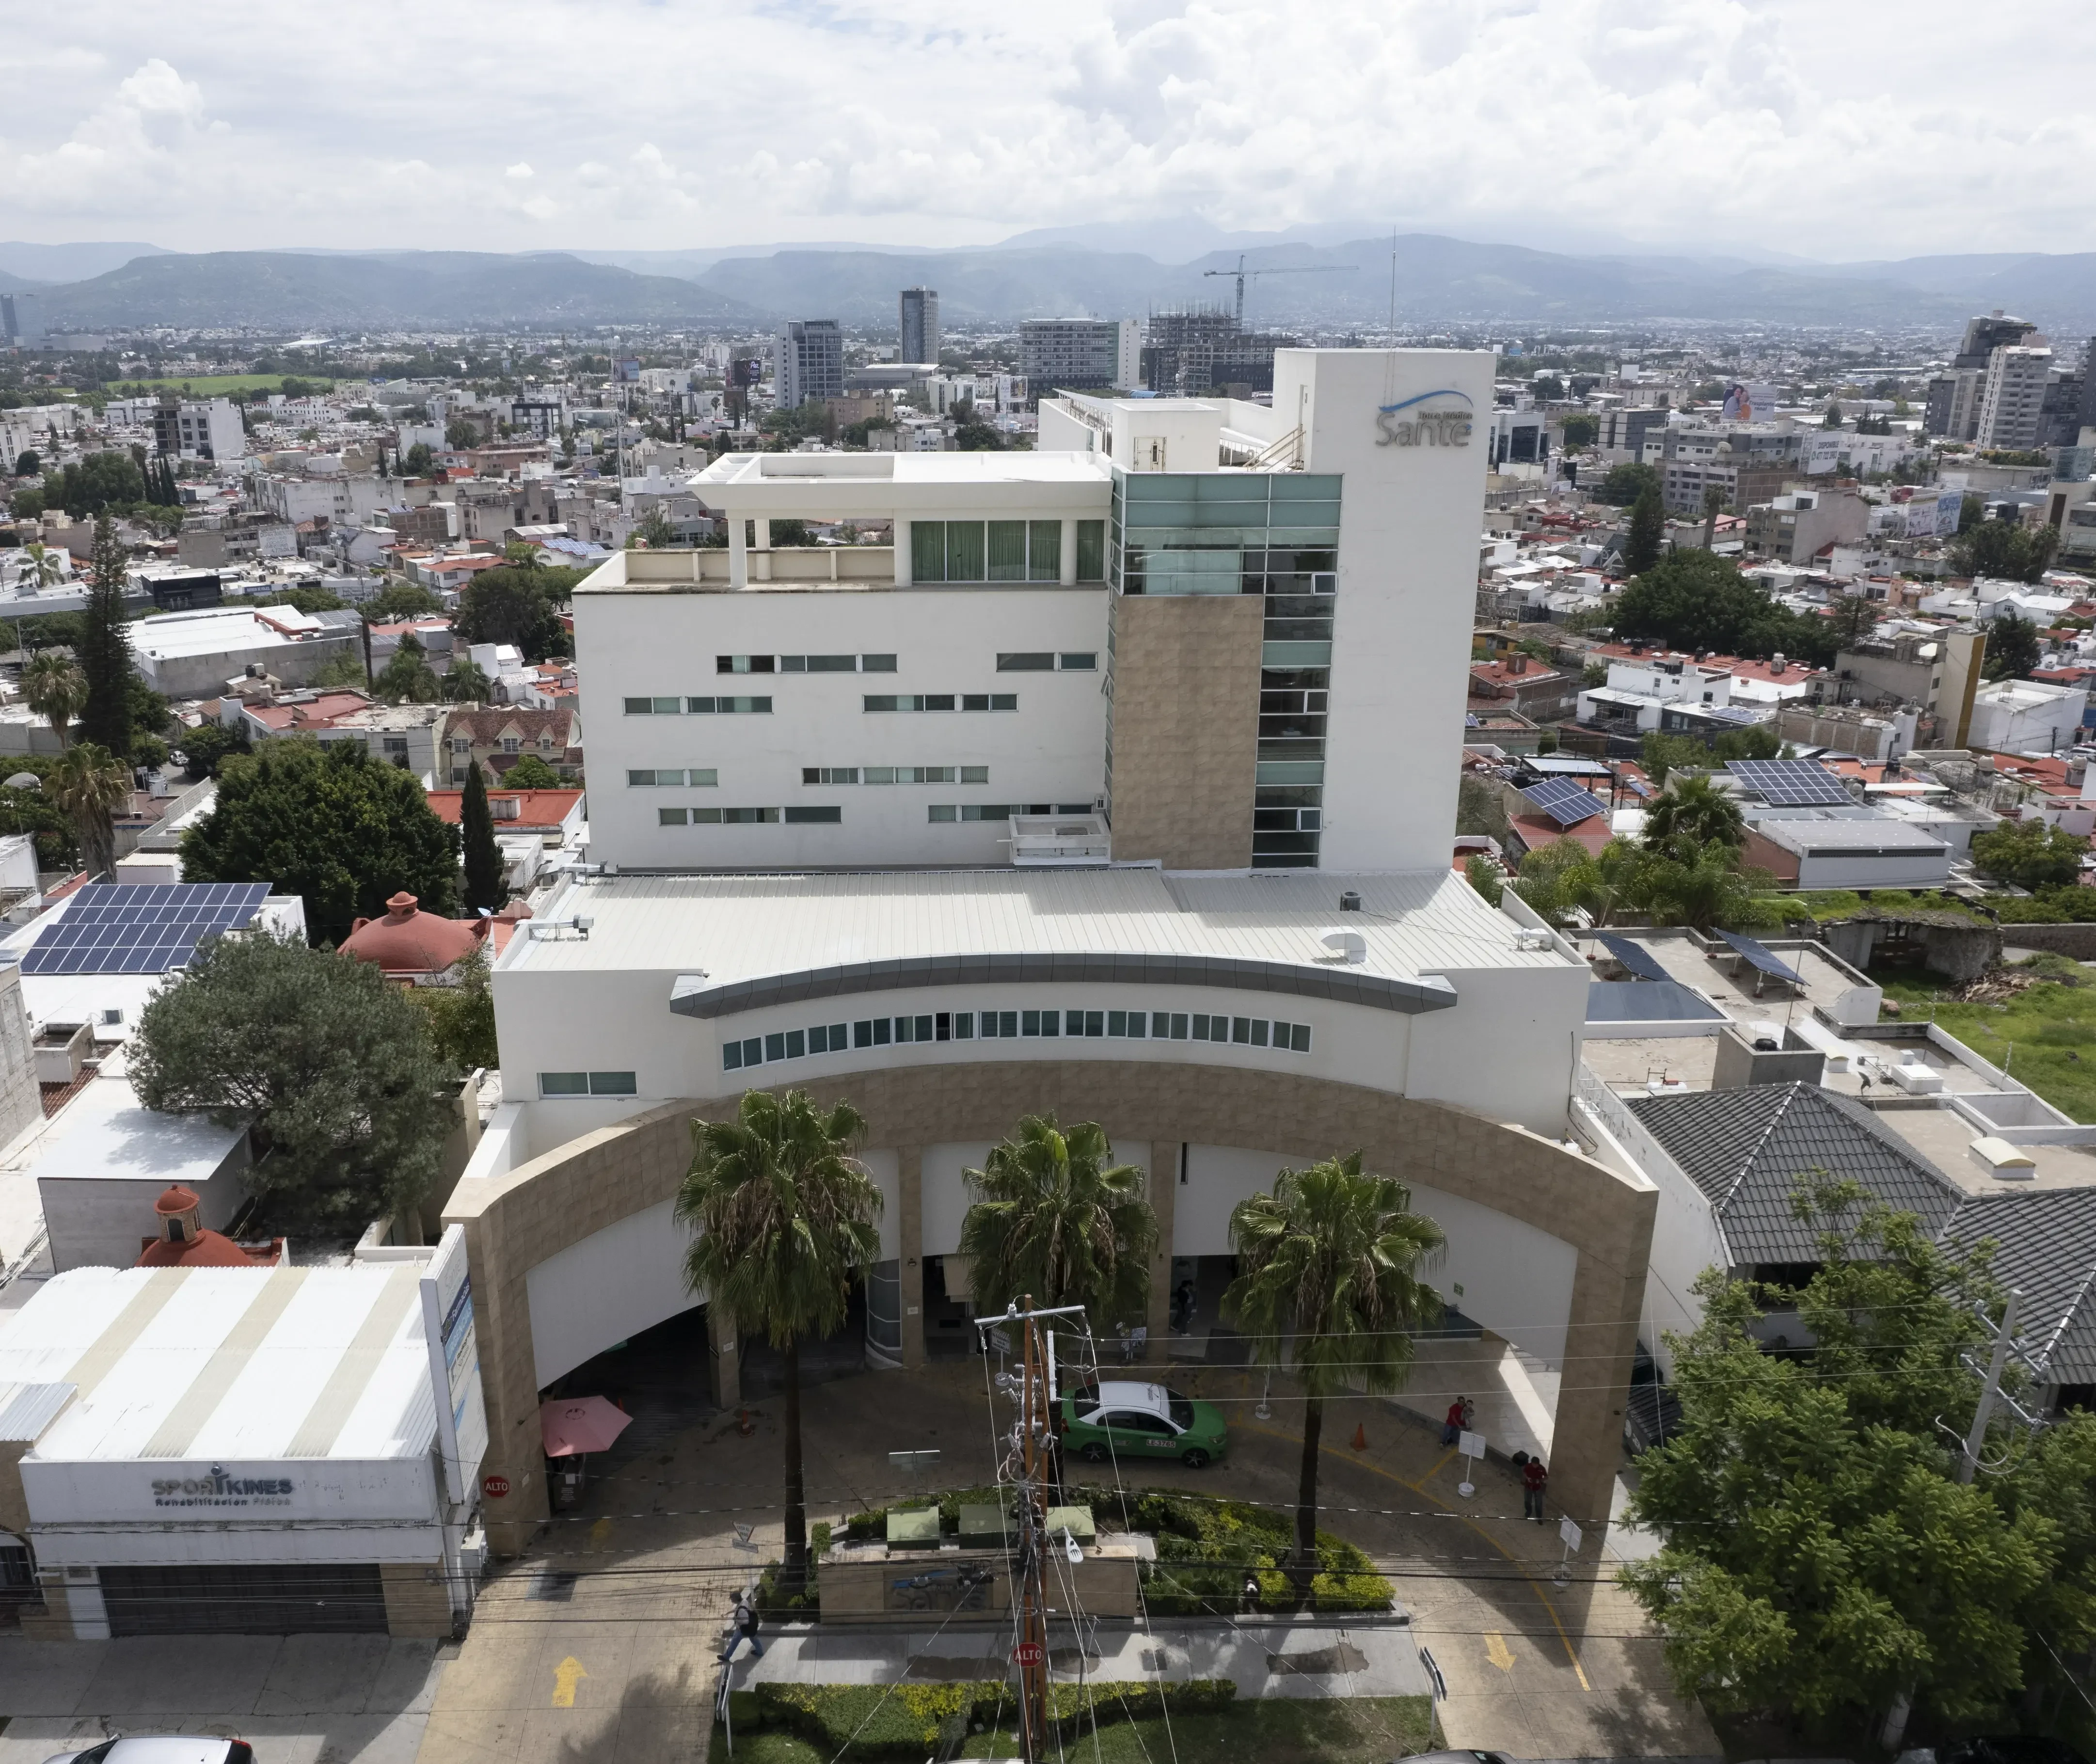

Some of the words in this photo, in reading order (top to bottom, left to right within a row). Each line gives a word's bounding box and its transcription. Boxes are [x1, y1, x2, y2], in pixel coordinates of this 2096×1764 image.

[1818, 441, 1839, 449] DISPONIBLE
[260, 529, 293, 538] DEPARTAMENTOS
[451, 1281, 470, 1322] Farmacias
[151, 1473, 293, 1495] SPORTKINES
[485, 1482, 508, 1491] ALTO
[1014, 1650, 1042, 1660] ALTO
